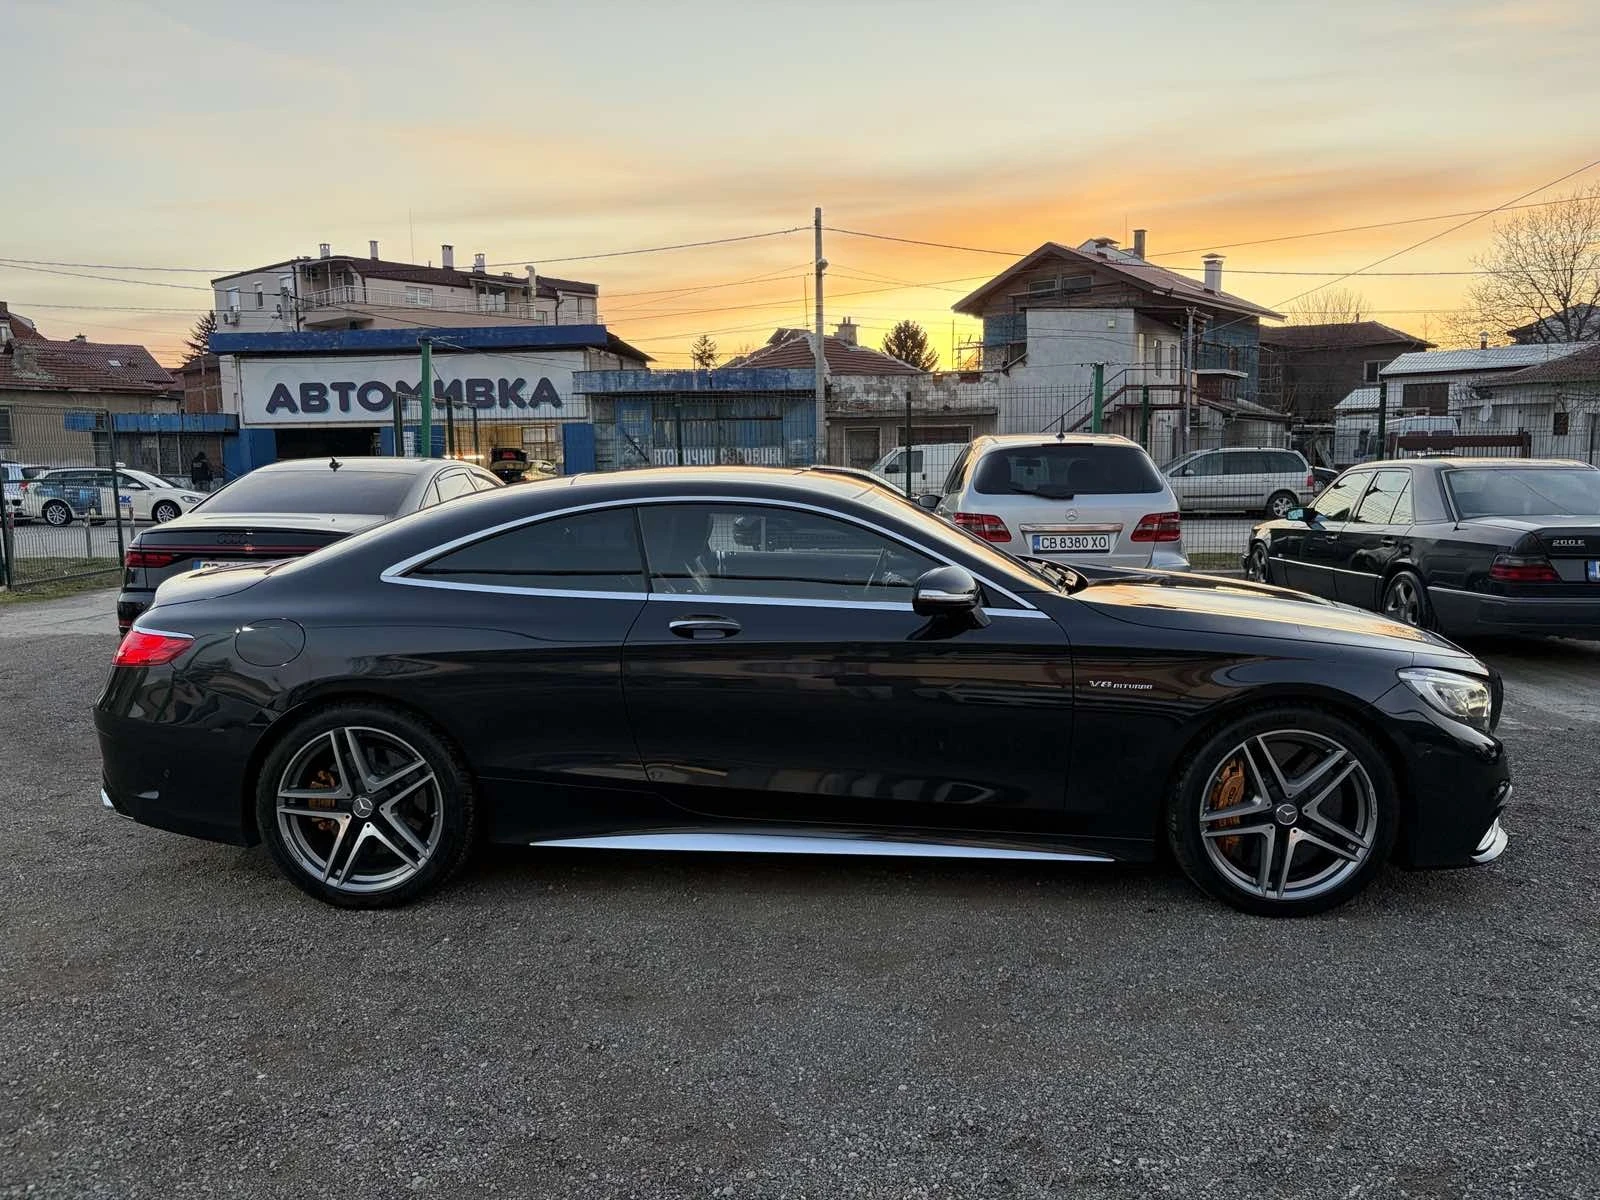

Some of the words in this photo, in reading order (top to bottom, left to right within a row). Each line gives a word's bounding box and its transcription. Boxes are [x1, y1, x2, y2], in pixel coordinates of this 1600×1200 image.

[266, 377, 563, 414] АВТОМИВКА
[1041, 536, 1057, 549] CB
[1059, 536, 1089, 549] 8380
[1091, 536, 1107, 549] XO
[1089, 680, 1112, 688] V8
